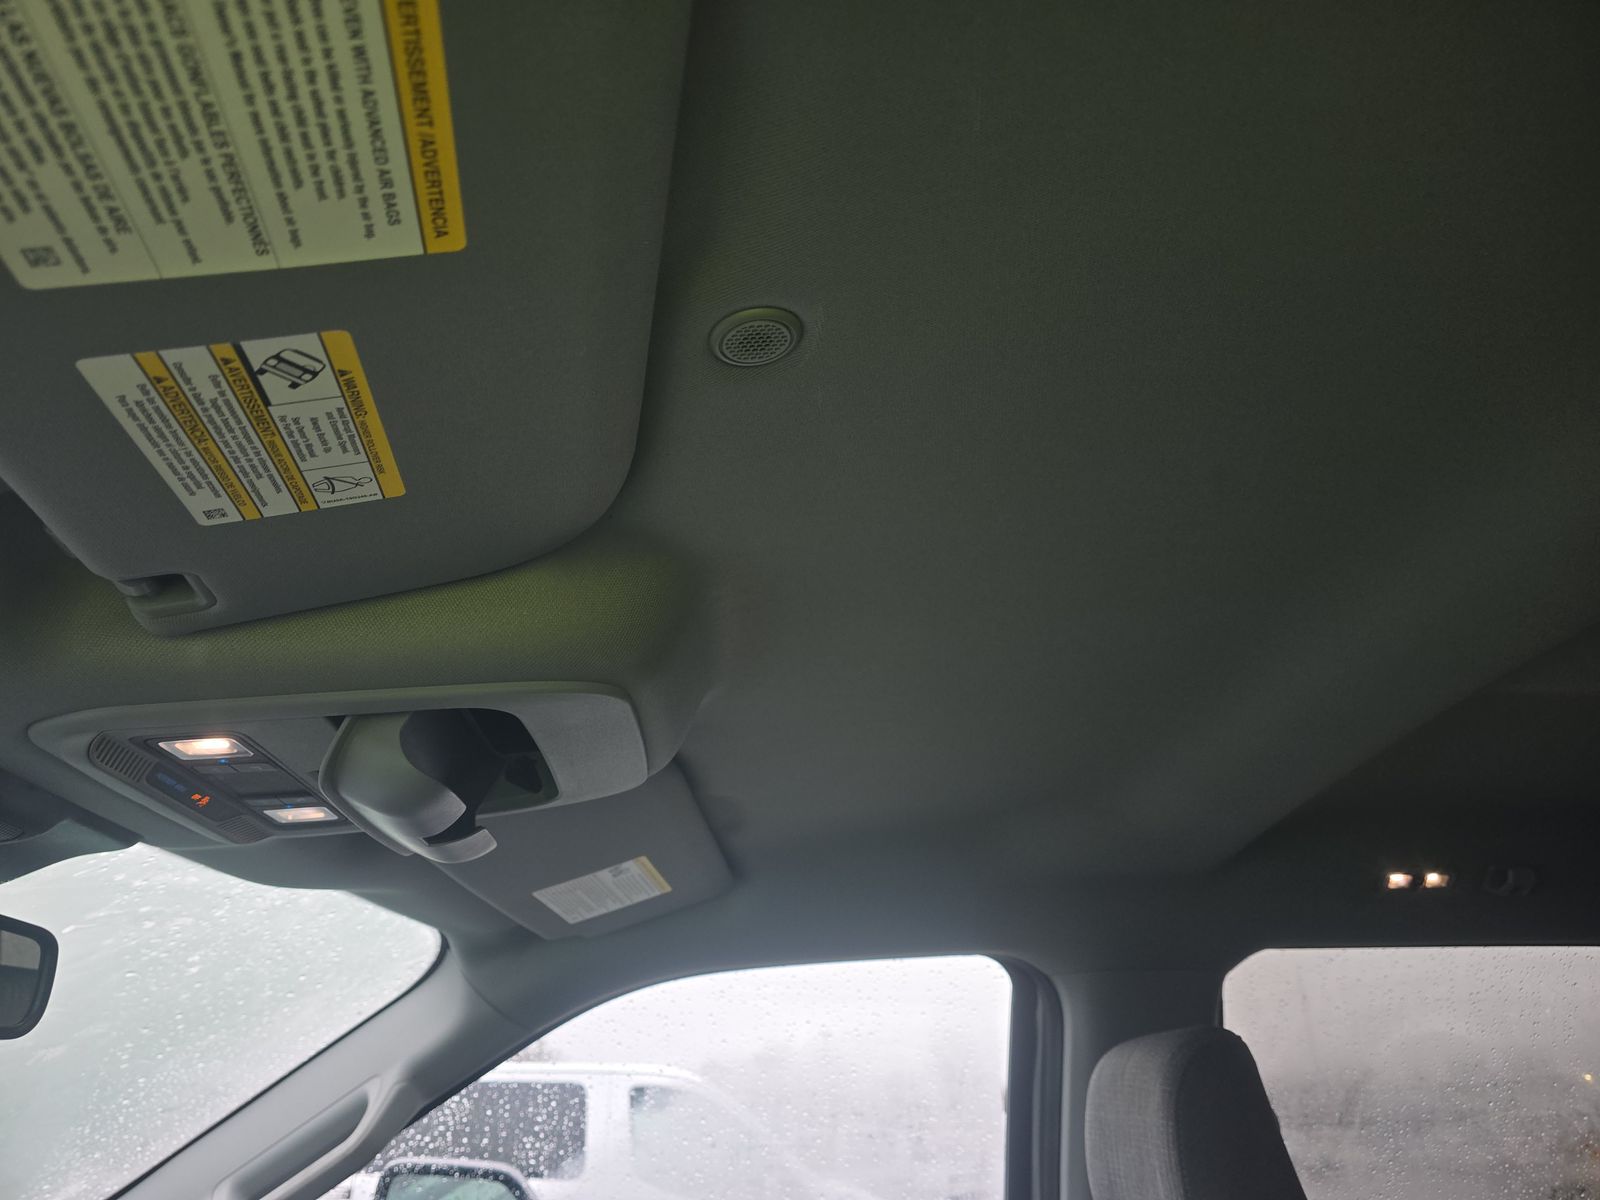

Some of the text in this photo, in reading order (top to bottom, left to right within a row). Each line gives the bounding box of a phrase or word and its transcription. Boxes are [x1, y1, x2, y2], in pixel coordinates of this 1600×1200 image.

[350, 44, 374, 84] WITH
[360, 88, 389, 165] ADVANCED
[217, 152, 272, 256] PERFECTIONNÉS
[376, 167, 394, 189] AIR
[381, 192, 401, 226] BAGS
[158, 384, 212, 447] ADVERTENCIA:
[223, 365, 277, 439] AVERTISSEMENT:
[340, 376, 368, 418] WARNING:
